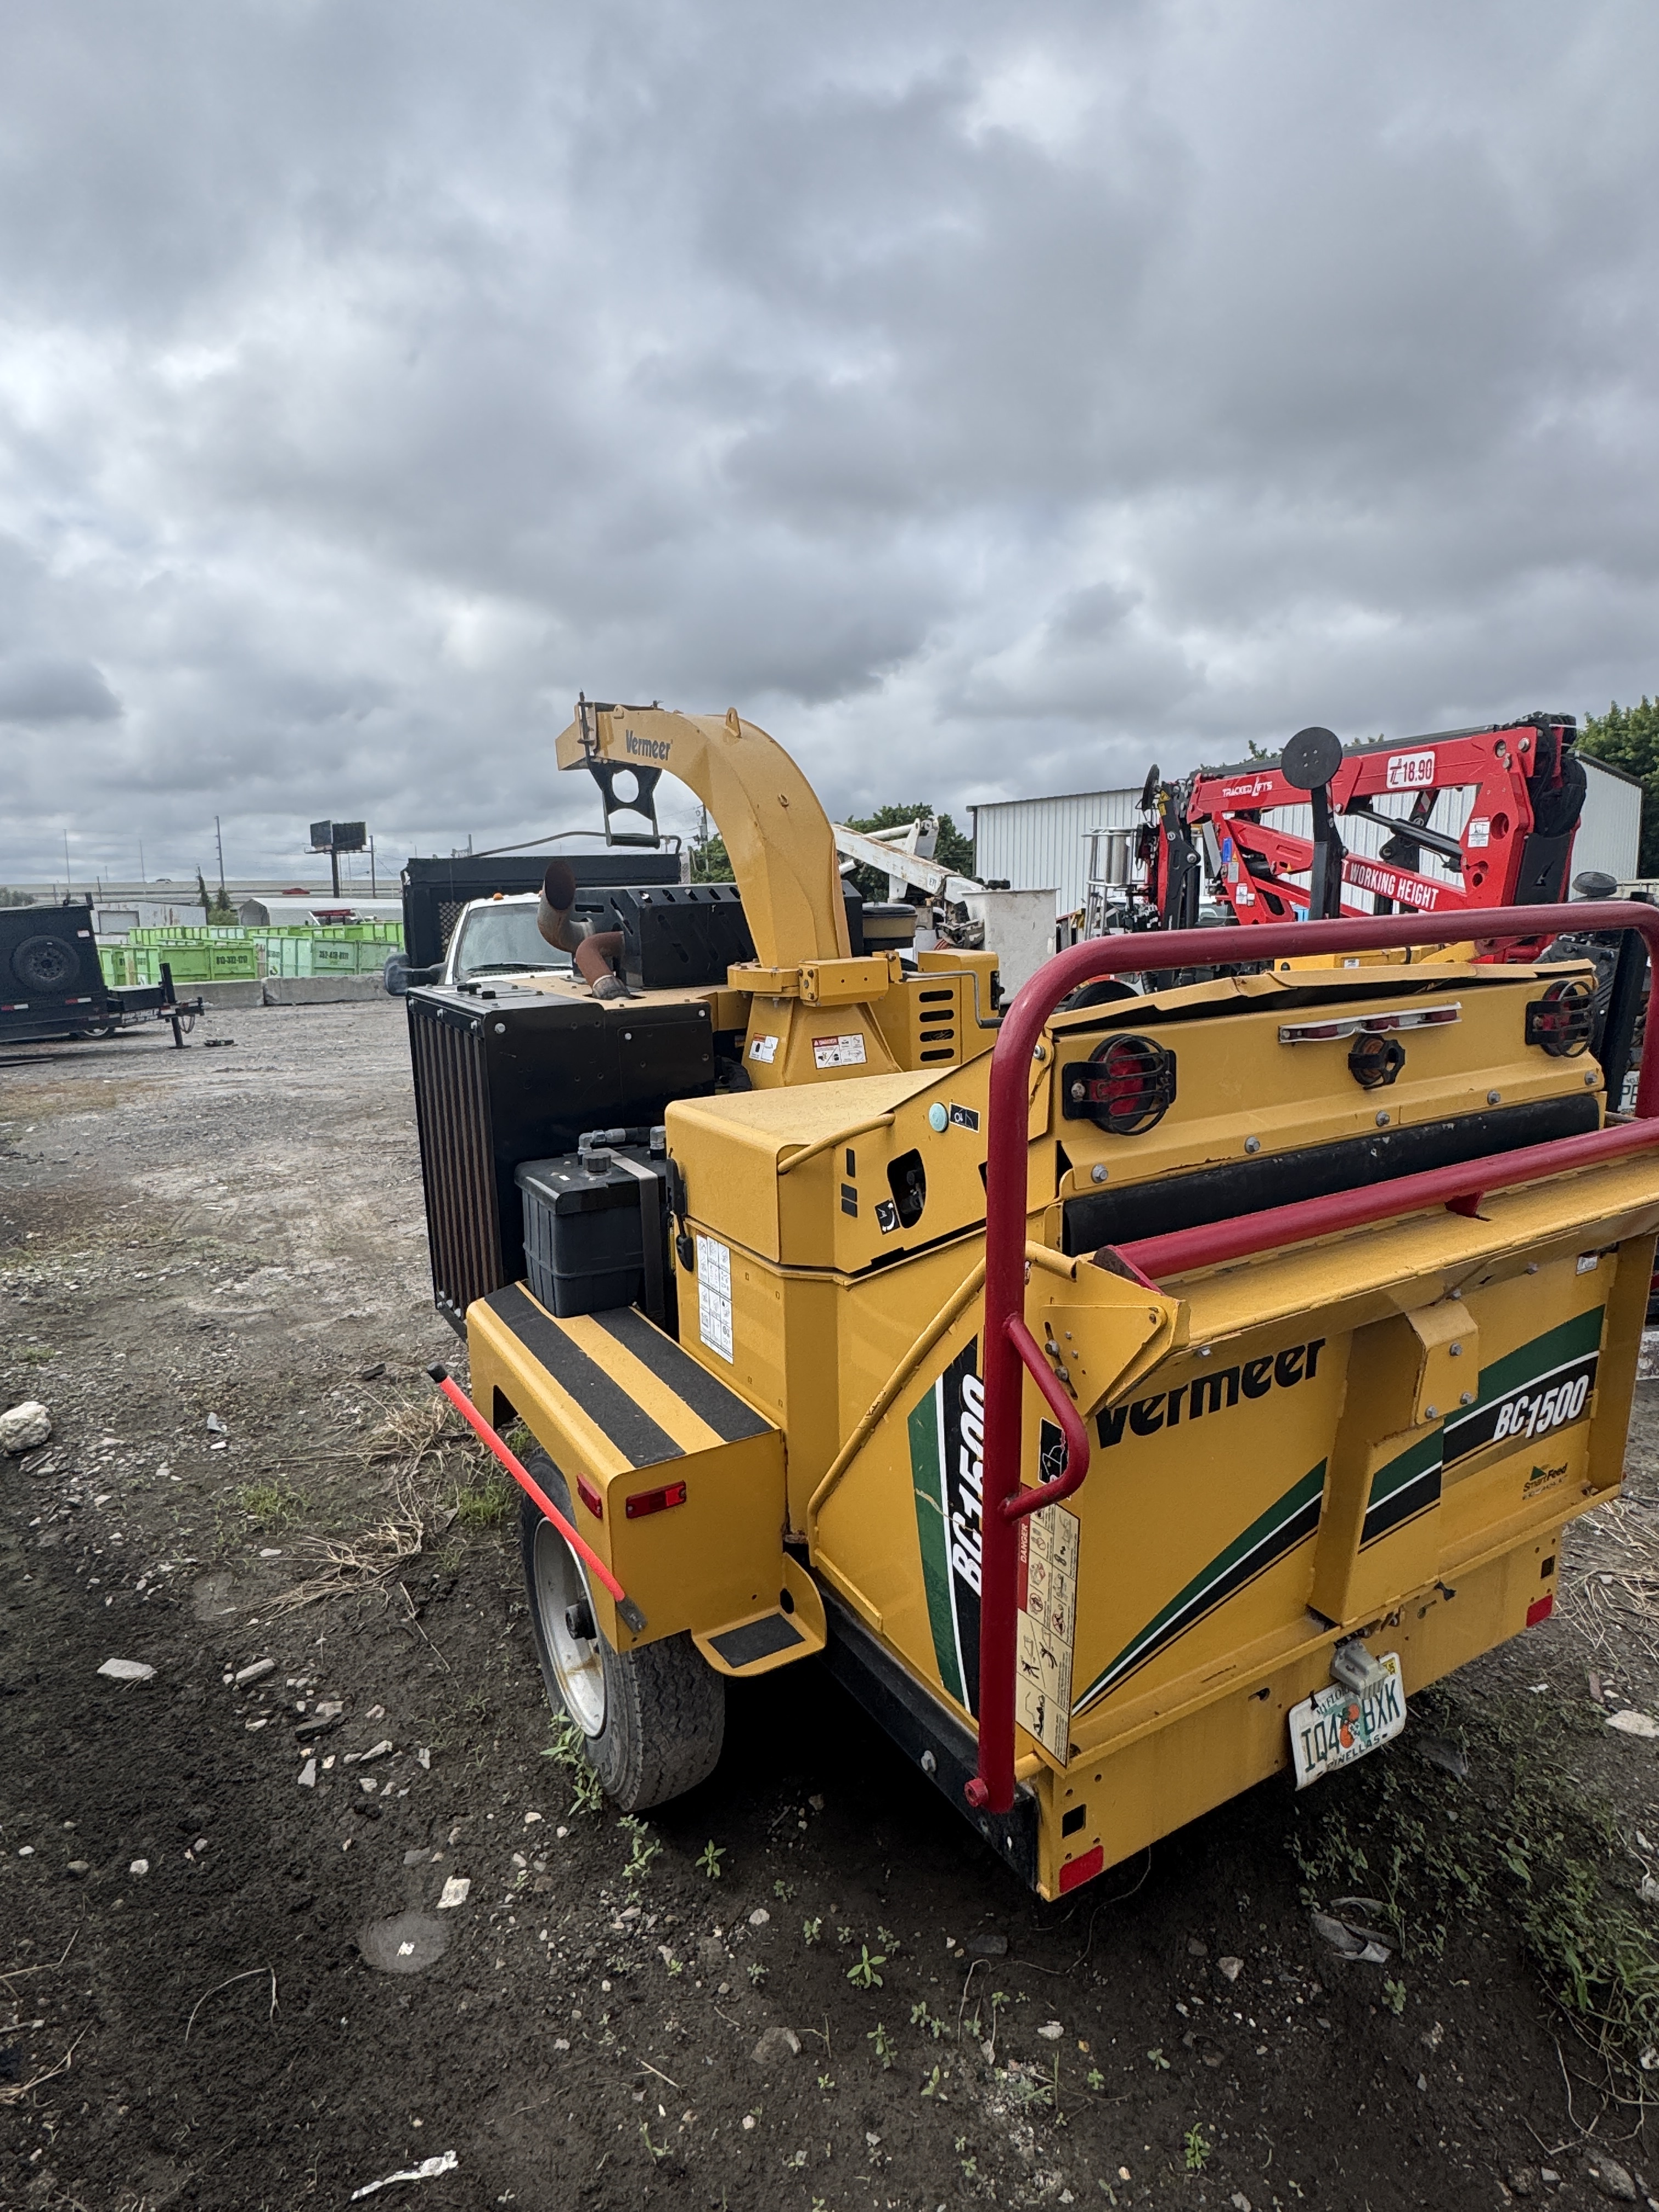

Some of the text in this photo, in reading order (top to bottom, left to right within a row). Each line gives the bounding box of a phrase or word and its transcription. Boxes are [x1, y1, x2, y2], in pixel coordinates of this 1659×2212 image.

[626, 729, 670, 761] Vermeer
[1222, 776, 1273, 797] TRACKED LIFTS
[1403, 758, 1432, 782] 18.90
[1341, 859, 1438, 910] T WORKING HEIGHT
[1492, 1375, 1589, 1442] BC1500
[1020, 1523, 1029, 1564] DANGER
[1328, 1734, 1380, 1769] PINELLAS
